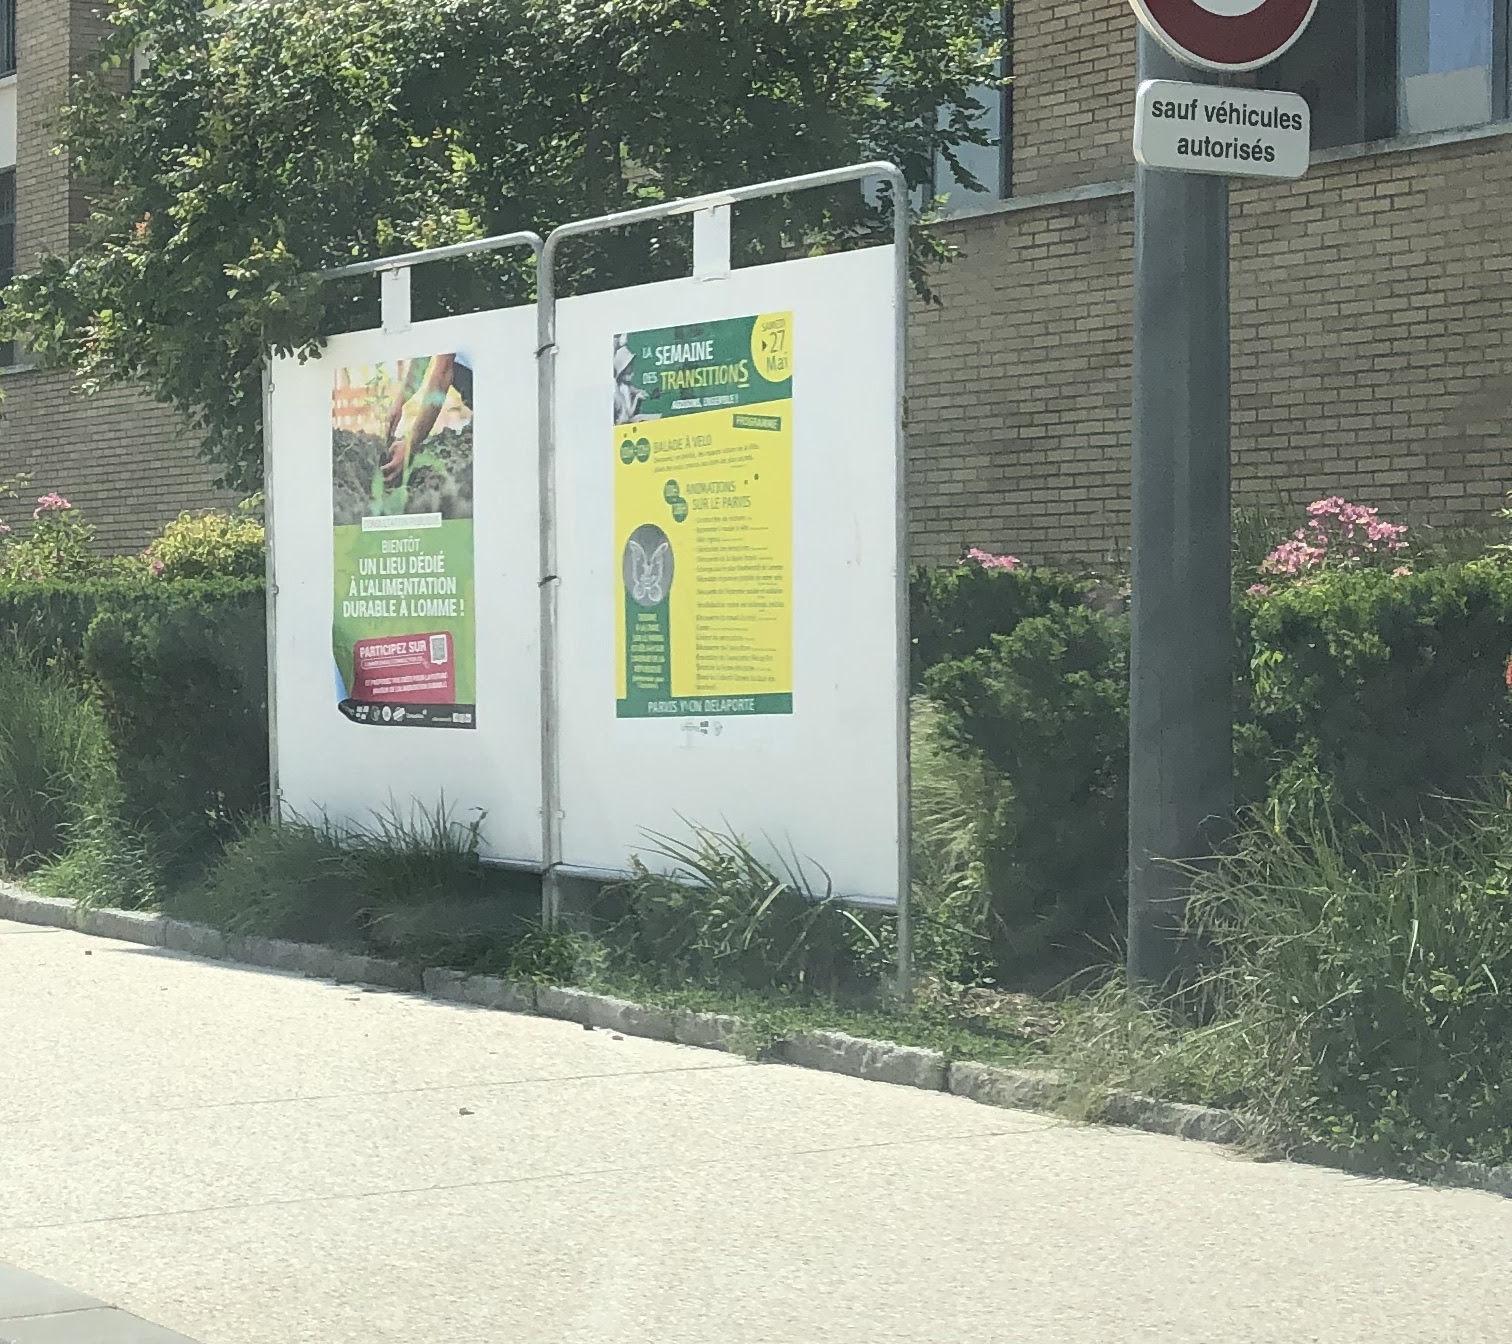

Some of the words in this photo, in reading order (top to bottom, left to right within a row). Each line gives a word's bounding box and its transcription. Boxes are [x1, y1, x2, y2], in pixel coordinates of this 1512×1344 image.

[1152, 99, 1198, 121] sauf
[1204, 101, 1303, 131] véhicules
[1177, 136, 1276, 163] autorisés
[770, 330, 785, 353] 27
[642, 348, 653, 359] LA
[655, 340, 714, 365] SEMAINE
[767, 352, 788, 373] Mai
[643, 372, 658, 384] DES
[660, 359, 749, 391] TRANSITIONS
[736, 415, 778, 429] PROGRAMME
[653, 438, 683, 454] BALADE
[686, 481, 736, 495] ANIMATIONS
[692, 498, 709, 511] SUR
[710, 497, 720, 510] LE
[722, 496, 752, 509] PARVIS
[381, 536, 421, 554] BIENTÔT
[359, 558, 377, 575] UN
[379, 557, 406, 575] LIEU
[409, 550, 445, 574] DÉDIÉ
[349, 576, 358, 596] À
[360, 577, 456, 597] L'ALIMENTATION
[343, 599, 397, 618] DURABLE
[399, 595, 408, 617] À
[410, 599, 457, 617] LOMME
[459, 599, 465, 616] !
[360, 642, 407, 659] PARTICIPEZ
[408, 640, 427, 653] SUR
[648, 701, 678, 713] PARVIS
[704, 698, 755, 712] DELAPORTE
